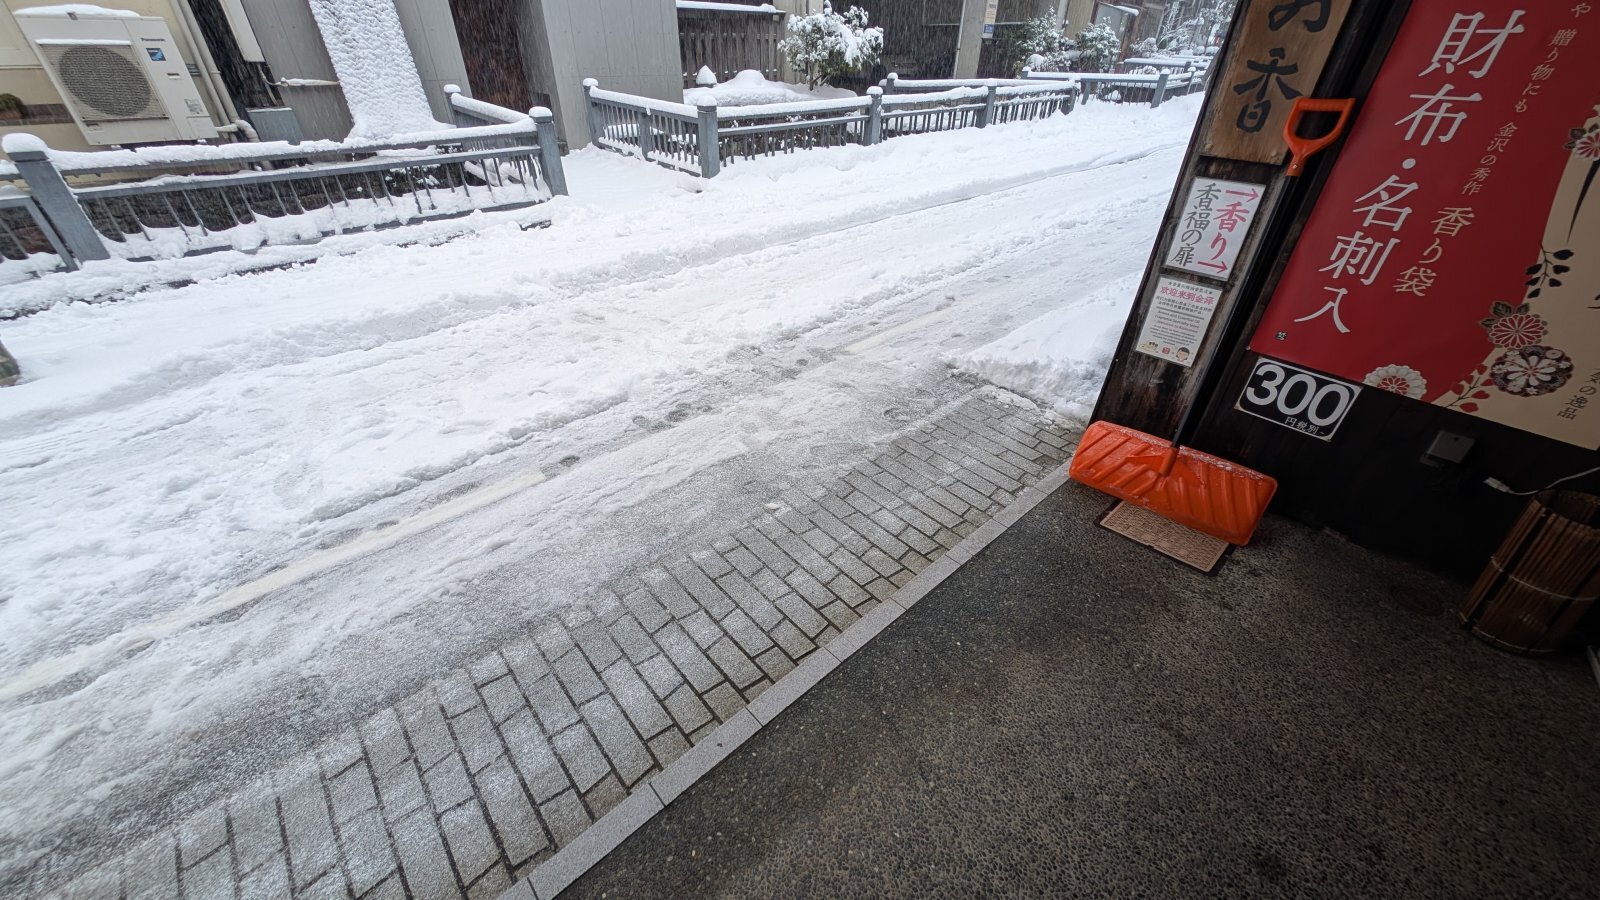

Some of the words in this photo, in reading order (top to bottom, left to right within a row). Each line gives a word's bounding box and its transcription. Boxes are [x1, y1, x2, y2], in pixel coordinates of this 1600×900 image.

[1515, 28, 1577, 113] 贈り物にも
[1461, 122, 1518, 196] 金沢の秀作
[1171, 182, 1221, 267] 香福の扉
[1213, 201, 1250, 261] 香り
[1391, 206, 1475, 297] 香り袋
[1246, 364, 1350, 427] 300
